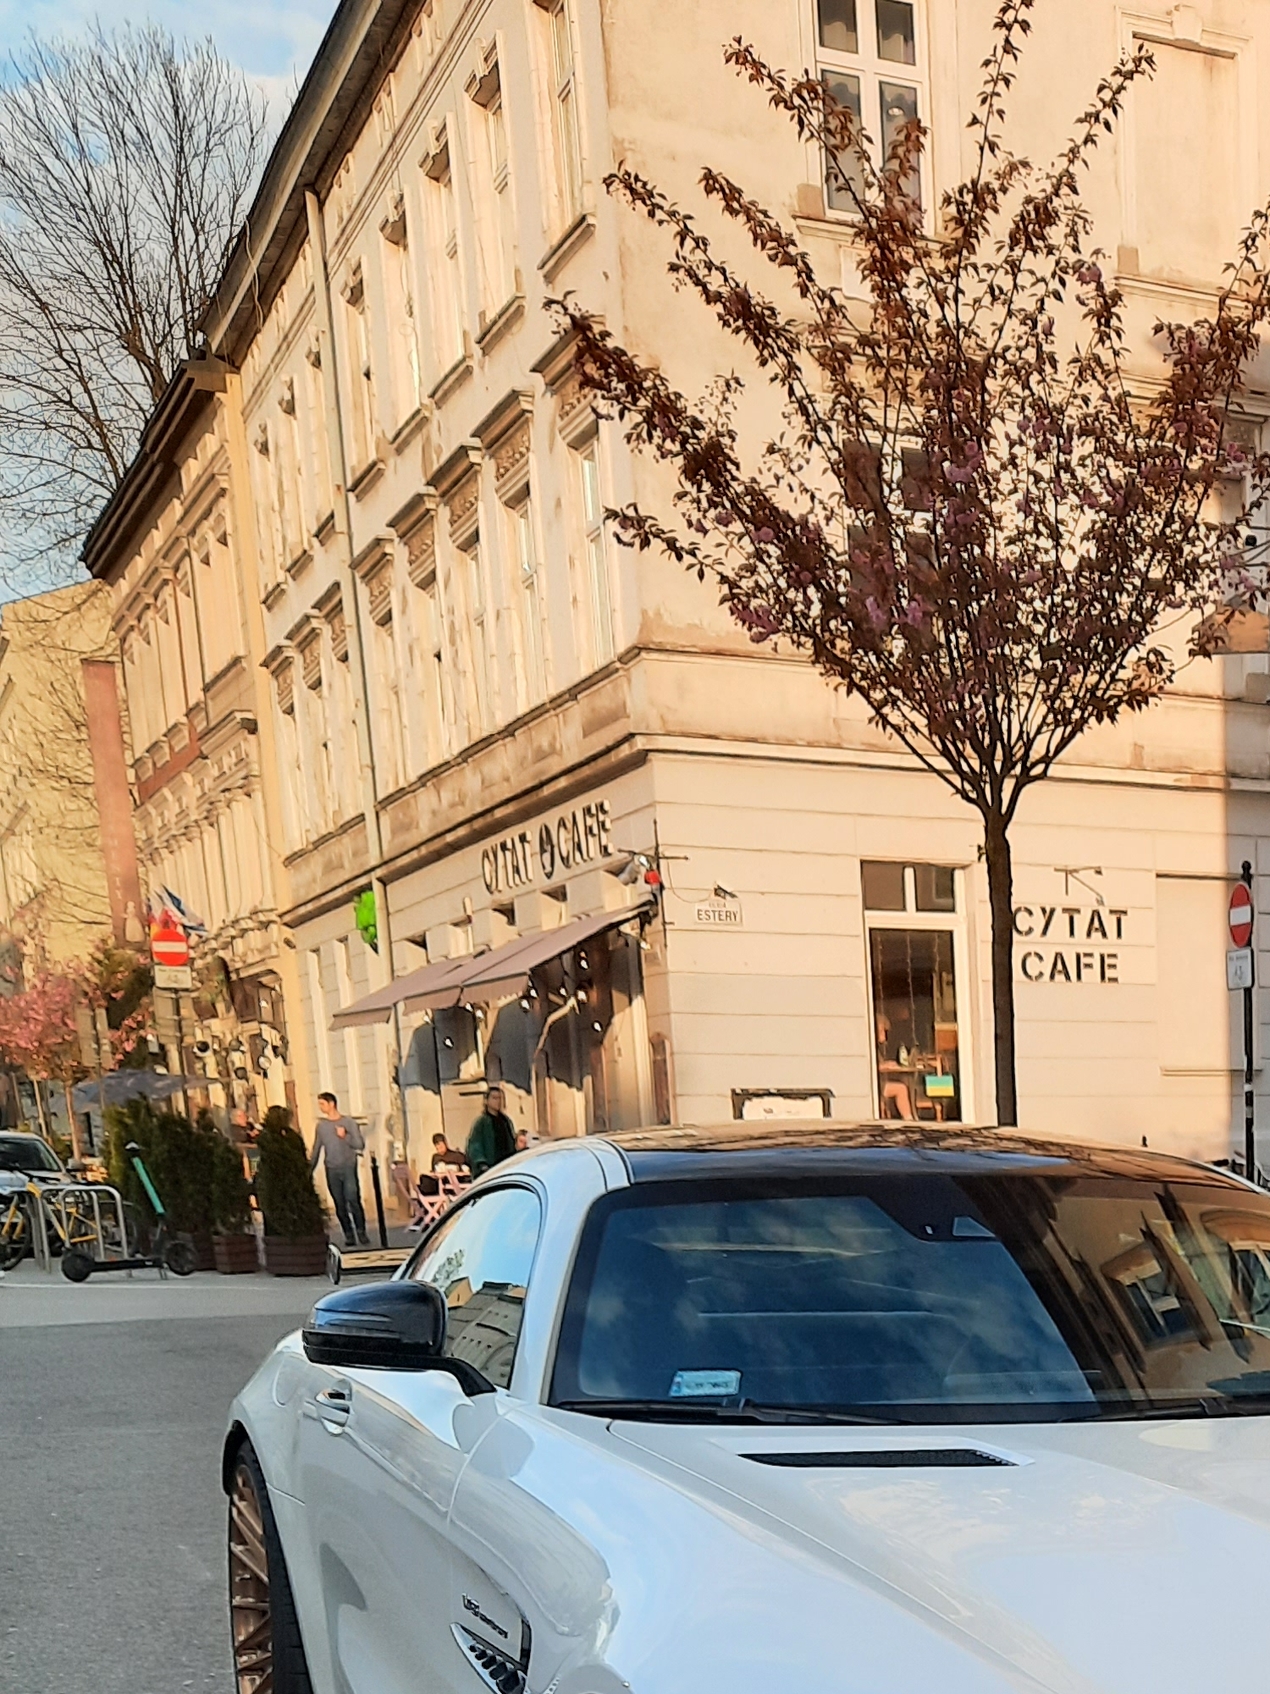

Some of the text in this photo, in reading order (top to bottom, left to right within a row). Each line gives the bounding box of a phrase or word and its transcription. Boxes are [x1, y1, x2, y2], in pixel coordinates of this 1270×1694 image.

[482, 799, 613, 895] CYTAT CAFE
[696, 908, 738, 922] ESTERY
[1013, 905, 1129, 940] CYTAT
[1021, 951, 1119, 984] CAFE
